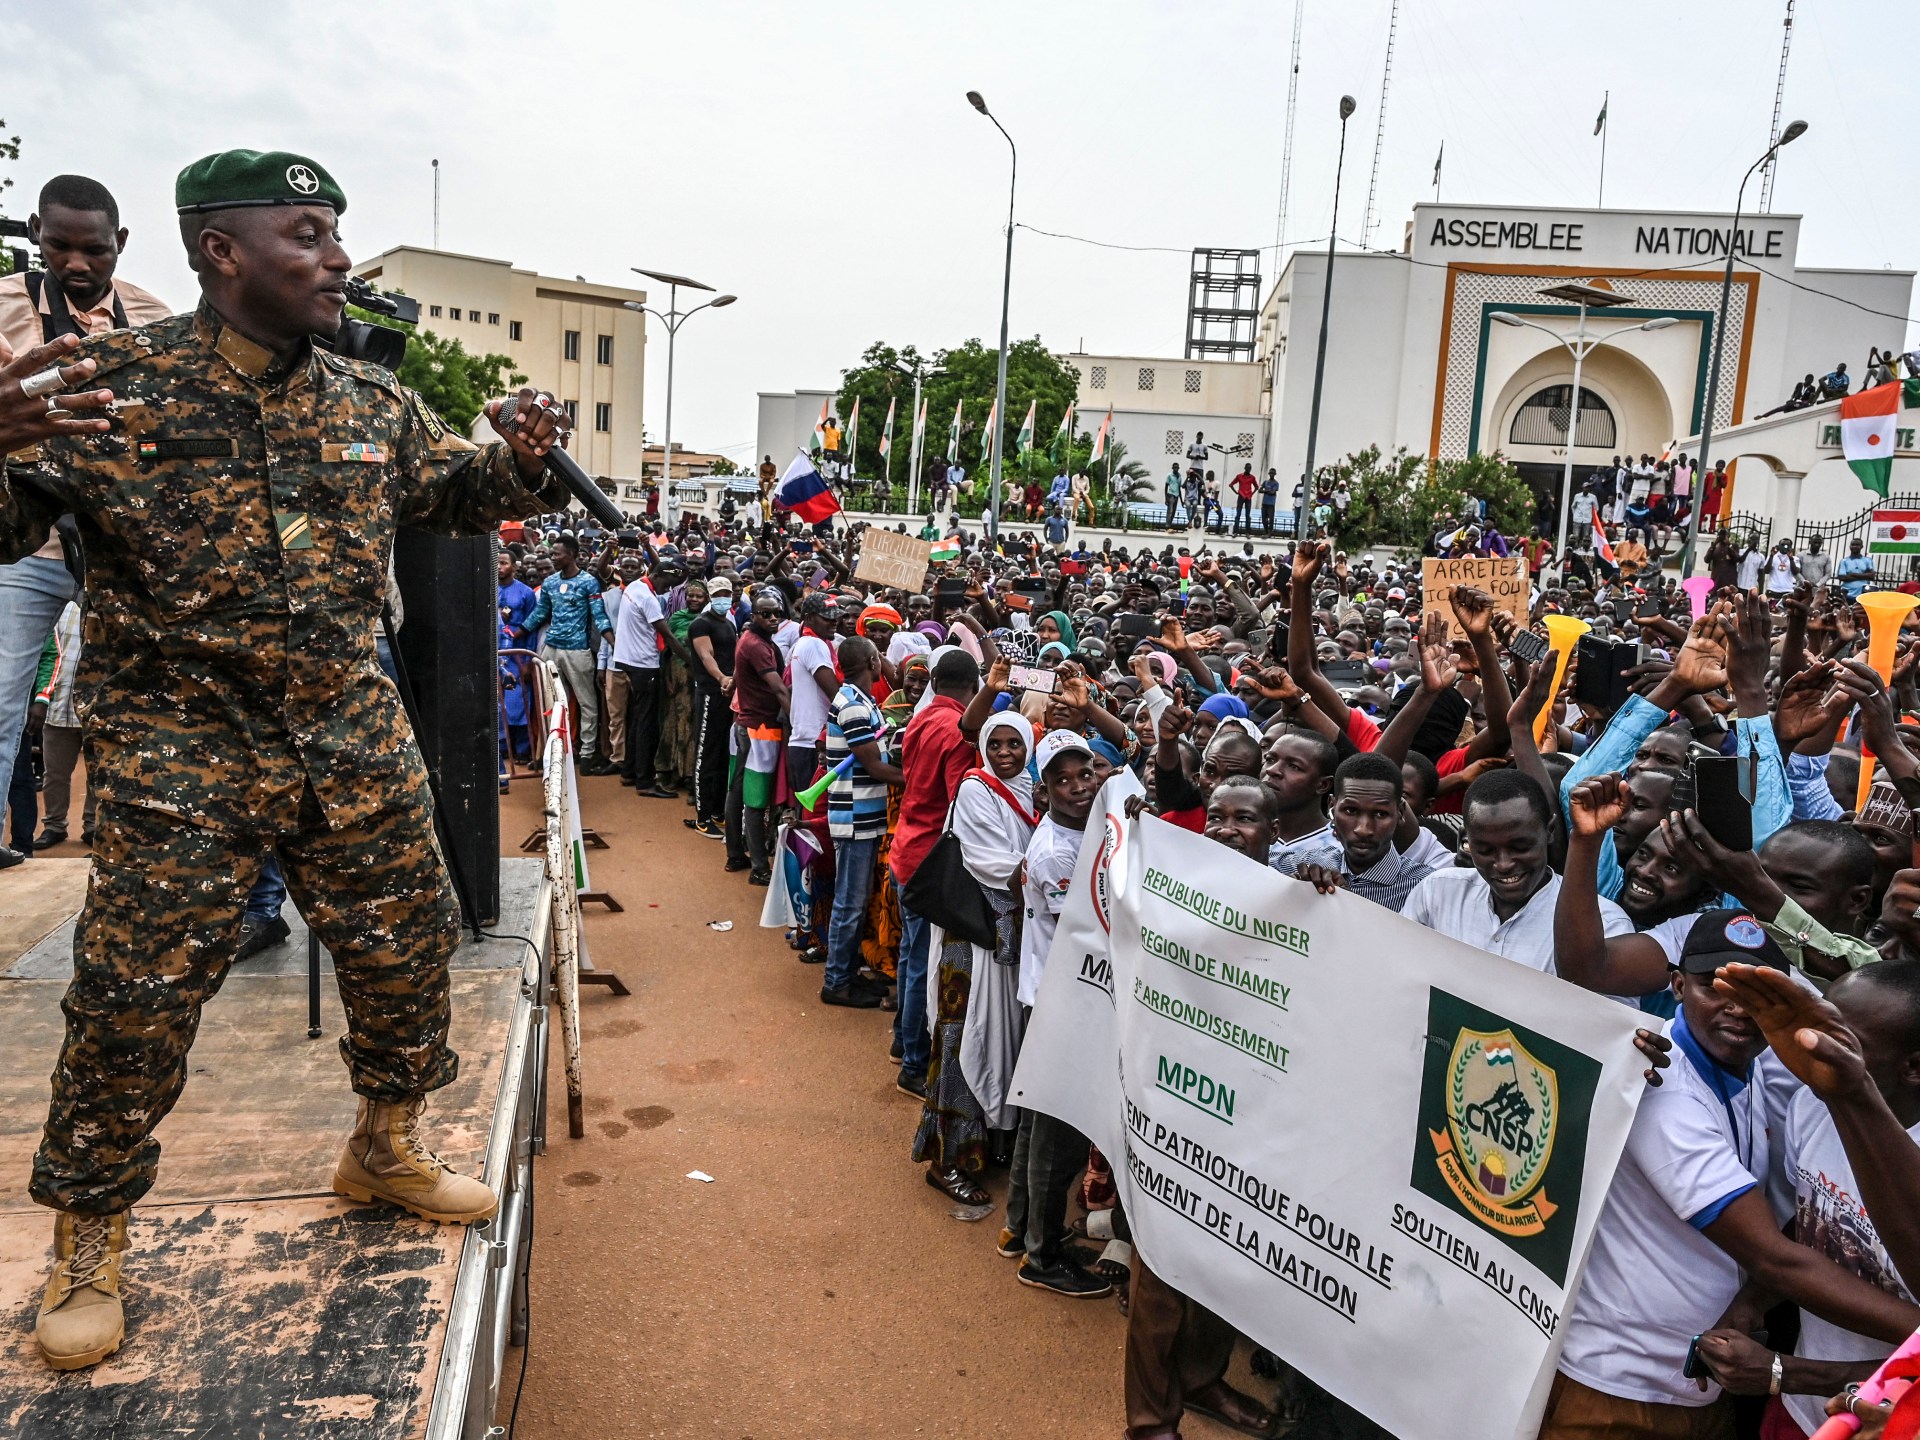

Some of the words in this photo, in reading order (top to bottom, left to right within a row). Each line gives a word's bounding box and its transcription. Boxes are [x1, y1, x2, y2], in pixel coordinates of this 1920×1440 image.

[1430, 218, 1584, 251] ASSEMBLEE
[1635, 226, 1784, 258] NATIONALE
[1425, 586, 1451, 603] IC
[1490, 580, 1520, 596] FOU
[1433, 560, 1524, 580] ARRETEZ
[1144, 867, 1221, 920] REPUBLIQUE
[1223, 906, 1247, 932] DU
[1253, 917, 1310, 952] NIGER
[1141, 926, 1190, 966] REGION
[1195, 953, 1217, 977] DE
[1221, 962, 1291, 1006] NIAMEY
[1143, 985, 1290, 1067] ARRONDISSEMENT
[1157, 1055, 1235, 1118] MPDN
[1466, 1103, 1533, 1158] CNSP
[1154, 1123, 1290, 1221] PATRIOTIQUE
[1295, 1203, 1361, 1263] POUR
[1366, 1245, 1394, 1283] LE
[1443, 1158, 1460, 1184] POUR
[1458, 1179, 1497, 1221] L'HONNEUR
[1495, 1212, 1505, 1224] DE
[1505, 1216, 1515, 1226] LA
[1514, 1213, 1538, 1227] PATRIE
[1205, 1202, 1232, 1238] DE
[1236, 1221, 1260, 1258] LA
[1266, 1241, 1358, 1317] NATION
[1391, 1203, 1480, 1272] SOUTIEN
[1484, 1260, 1513, 1295] AU
